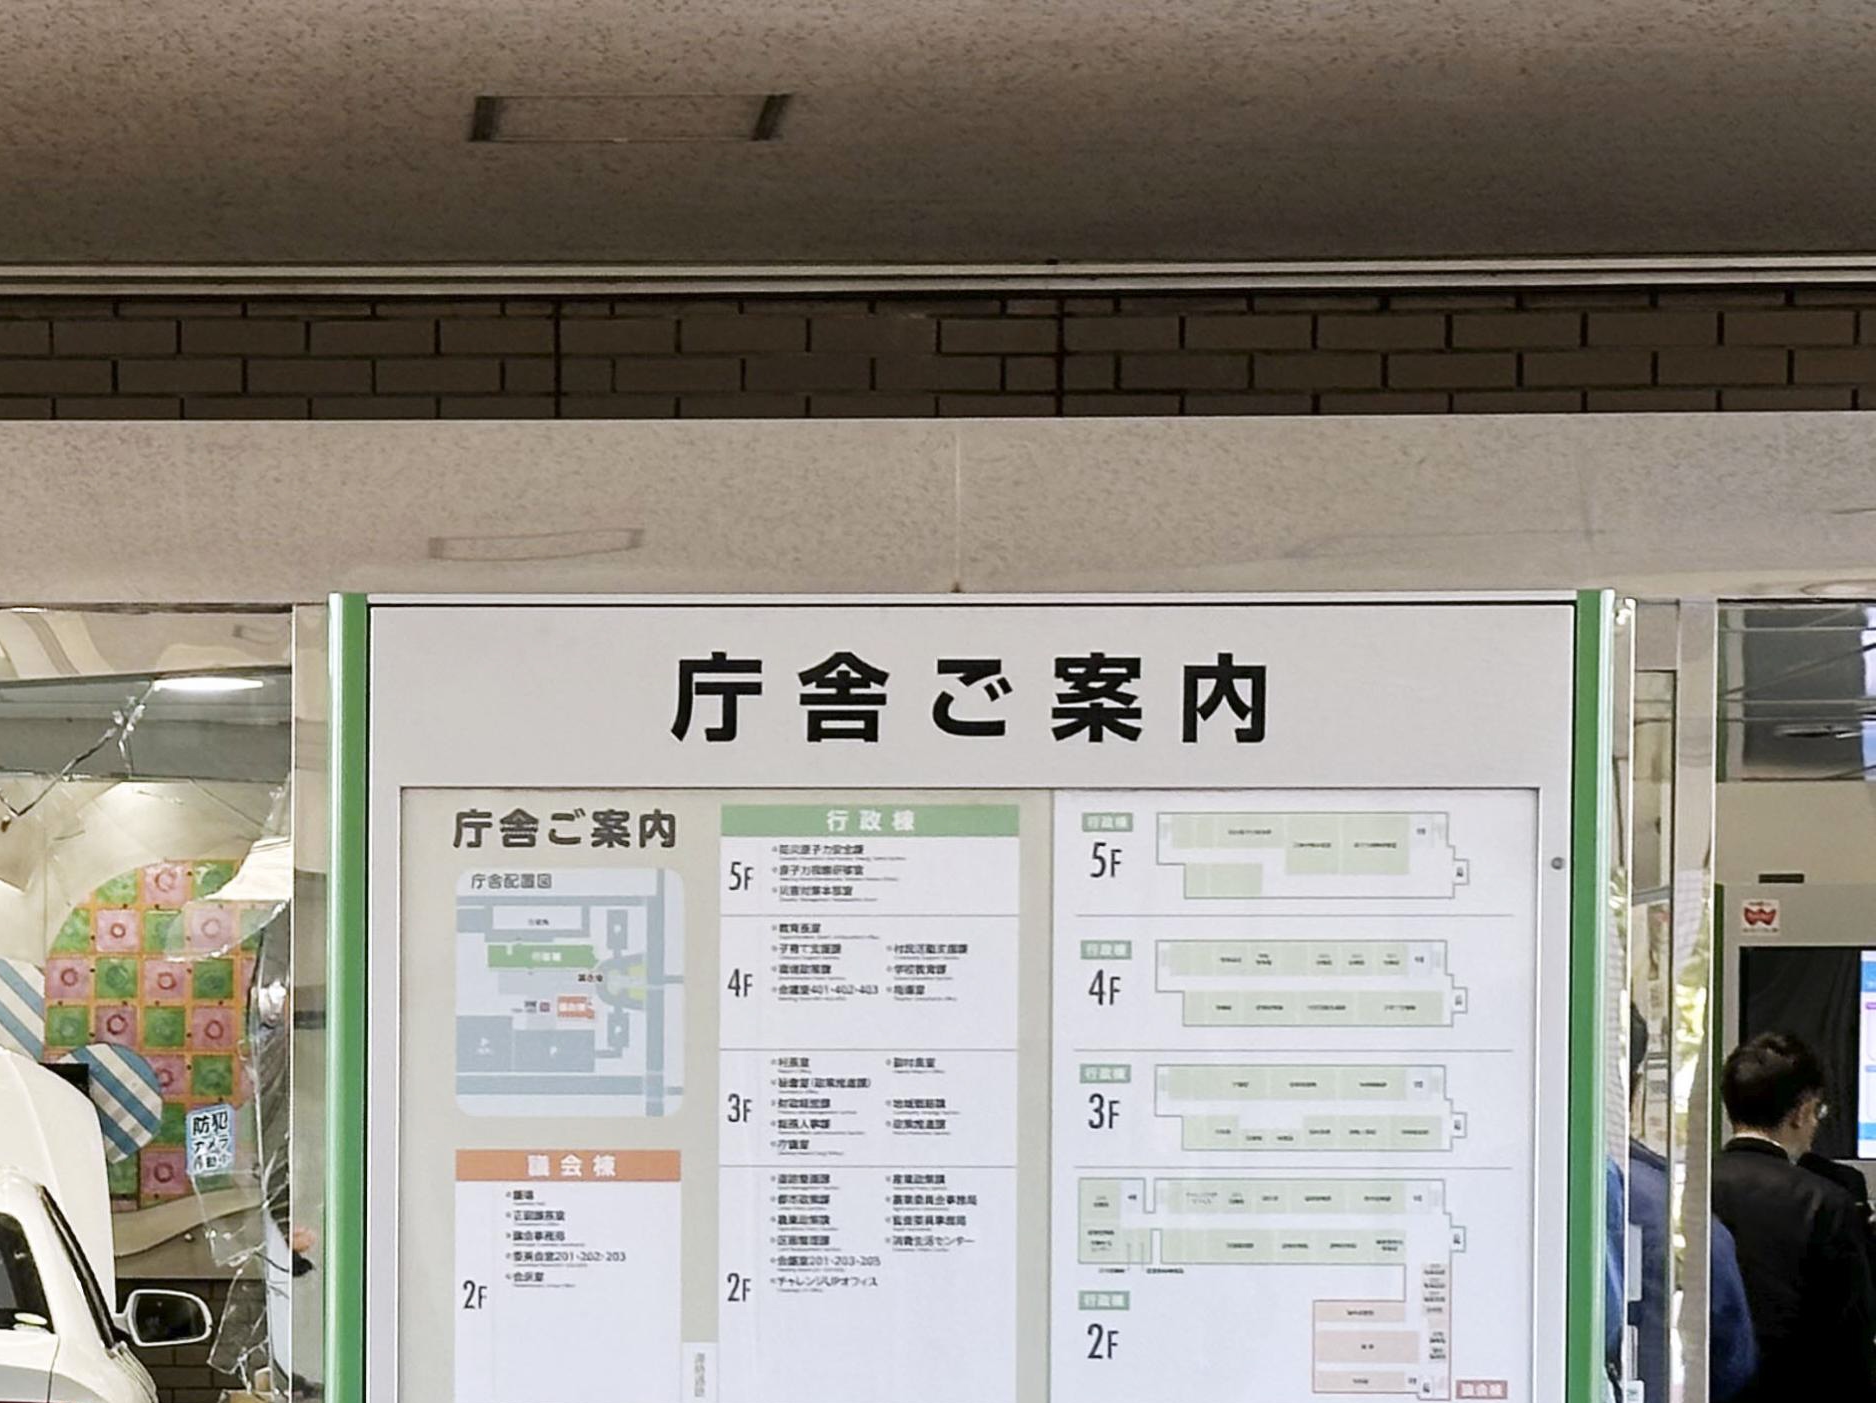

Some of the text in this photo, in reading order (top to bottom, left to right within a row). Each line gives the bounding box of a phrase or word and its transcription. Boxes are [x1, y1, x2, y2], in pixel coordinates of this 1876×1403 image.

[671, 651, 1267, 743] 庁舎ご案内
[453, 808, 676, 848] 庁舎ご案内
[827, 809, 915, 832] 行政棟
[1090, 842, 1122, 878] 5F
[471, 873, 552, 890] 庁舎配置図
[728, 861, 754, 891] 5F
[728, 968, 753, 998] 4F
[1088, 969, 1121, 1006] 4F
[193, 1110, 228, 1136] 防犯
[727, 1093, 752, 1123] 3F
[1088, 1093, 1121, 1130] 3F
[528, 1155, 616, 1177] 議会棟
[892, 1236, 975, 1246] 消費生活センター
[463, 1280, 487, 1309] 2F
[727, 1273, 751, 1302] 2F
[1087, 1323, 1119, 1360] 2F
